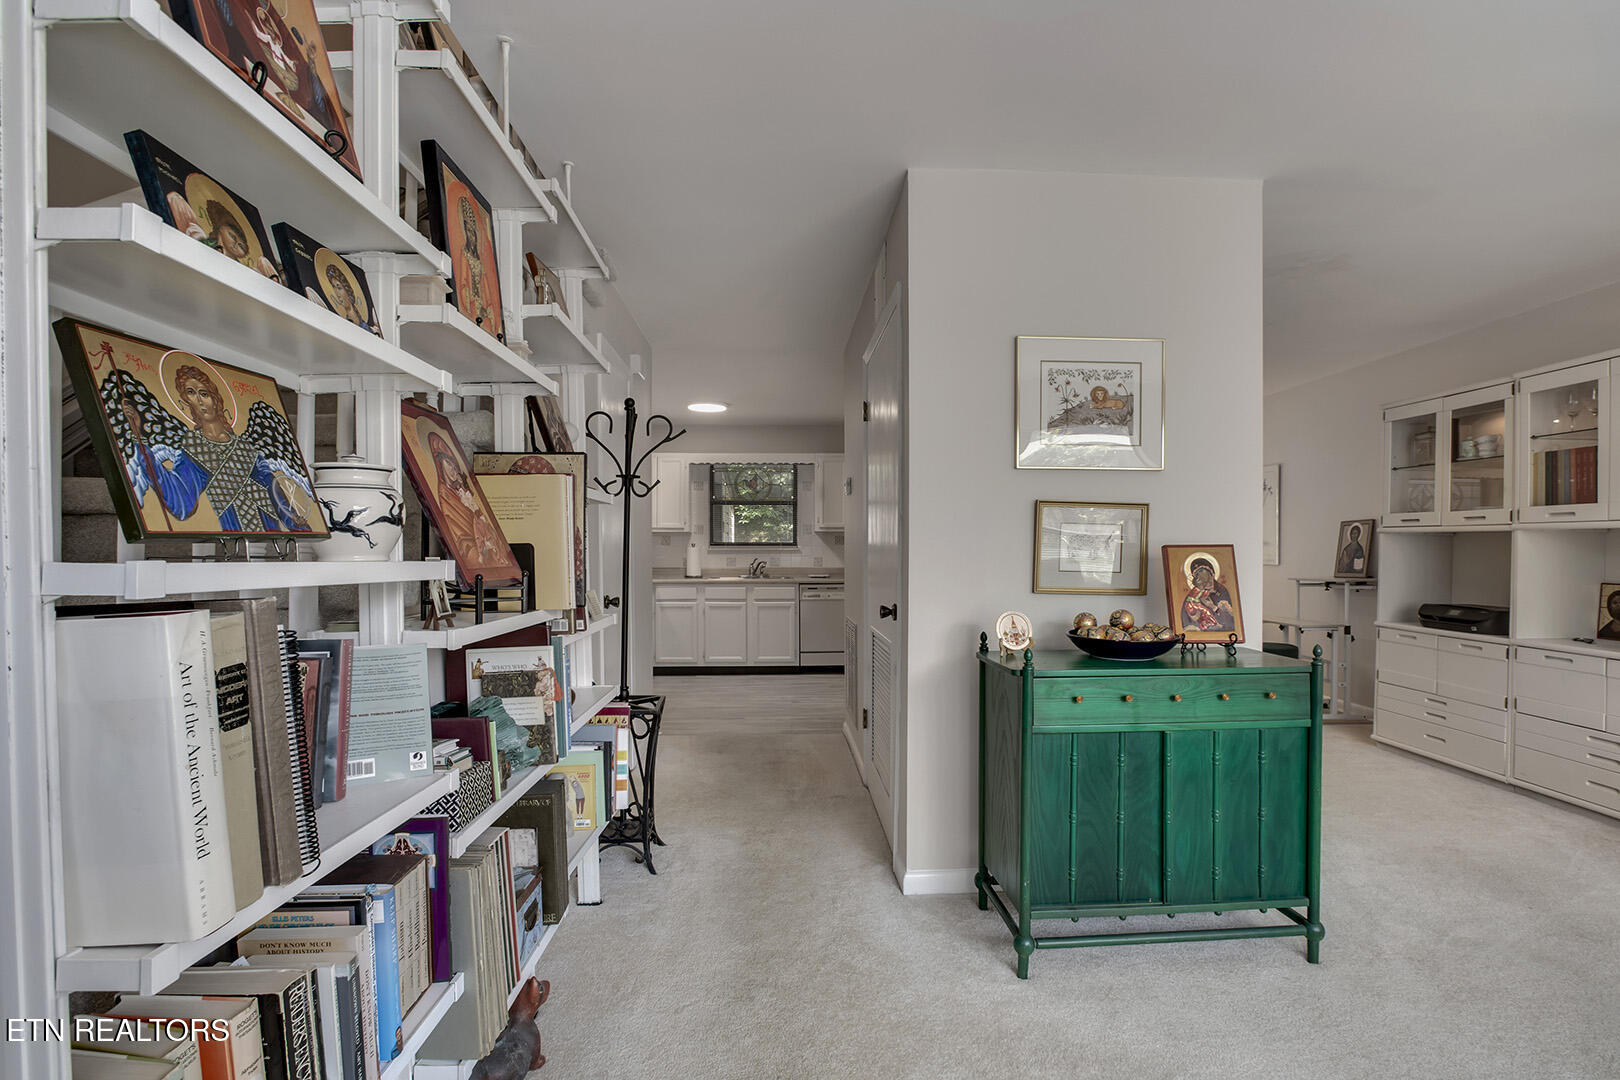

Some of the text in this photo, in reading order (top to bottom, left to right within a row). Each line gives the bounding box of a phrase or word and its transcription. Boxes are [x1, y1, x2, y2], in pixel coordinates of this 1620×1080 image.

[226, 693, 244, 705] ART
[179, 661, 211, 860] Art of the Ancient World
